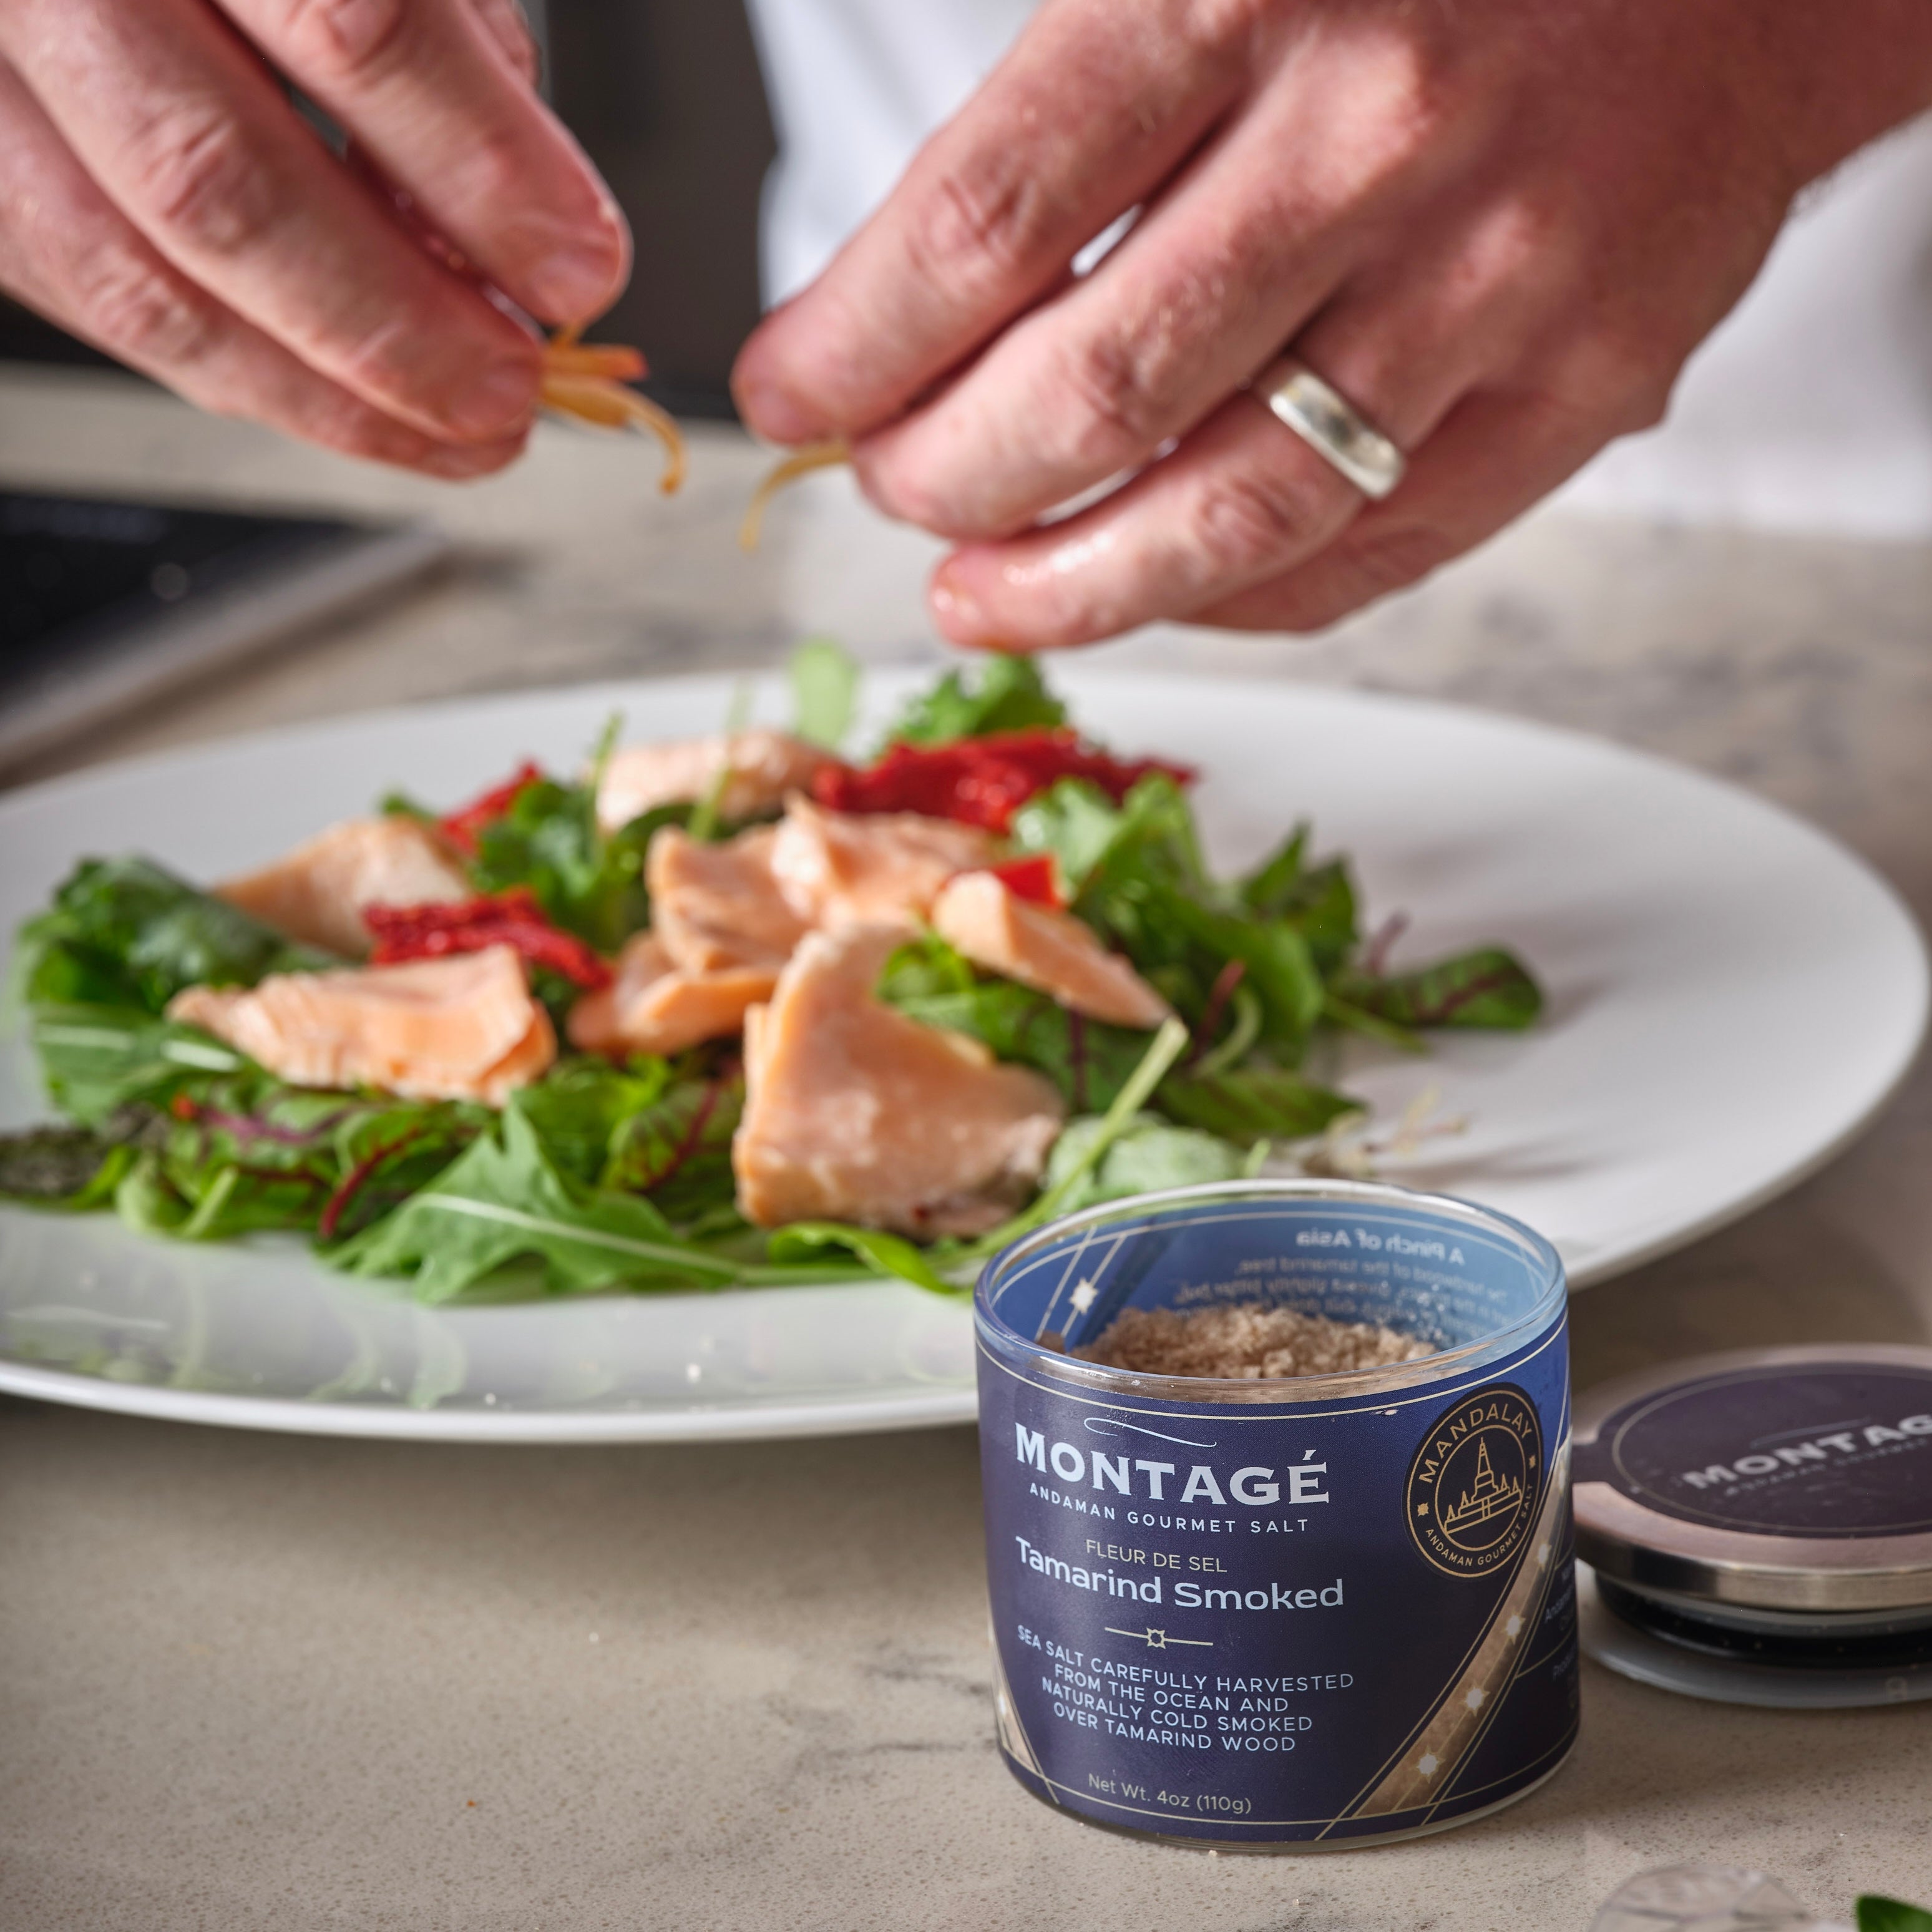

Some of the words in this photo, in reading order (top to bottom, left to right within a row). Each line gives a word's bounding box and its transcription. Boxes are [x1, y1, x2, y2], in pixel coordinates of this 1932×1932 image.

[1015, 1422, 1329, 1506] MONTAGÉ
[1418, 1403, 1533, 1483] MANDALAY
[1030, 1482, 1115, 1520] ANDAMAN
[1127, 1511, 1236, 1533] GOURMET
[1251, 1519, 1308, 1533] SALT
[1425, 1528, 1473, 1566] ANDAMAN
[1477, 1523, 1523, 1566] GOURMET
[1520, 1483, 1533, 1518] SALT
[1015, 1536, 1162, 1604] Tamarind
[1174, 1578, 1344, 1610] Smoked
[1086, 1539, 1146, 1564] FLEUR
[1153, 1552, 1181, 1569] DE
[1189, 1556, 1227, 1573] SEL
[1017, 1624, 1042, 1651] SEA
[1045, 1640, 1084, 1667] SALT
[1090, 1657, 1208, 1690] CAREFULLY
[1217, 1674, 1354, 1692] HARVESTED
[1042, 1676, 1142, 1720] NATURALLY
[1151, 1709, 1208, 1729] COLD
[1217, 1716, 1312, 1732] SMOKED
[1055, 1663, 1101, 1692] FROM
[1108, 1681, 1146, 1702] THE
[1154, 1690, 1229, 1711] OCEAN
[1240, 1697, 1289, 1712] AND
[1053, 1702, 1098, 1730] OVER
[1105, 1719, 1212, 1749] TAMARIND
[1221, 1736, 1295, 1751] WOOD
[1088, 1773, 1116, 1795] Net
[1121, 1782, 1151, 1802] Wt.
[1156, 1790, 1190, 1808] 4oz
[1196, 1794, 1252, 1815] (110g)
